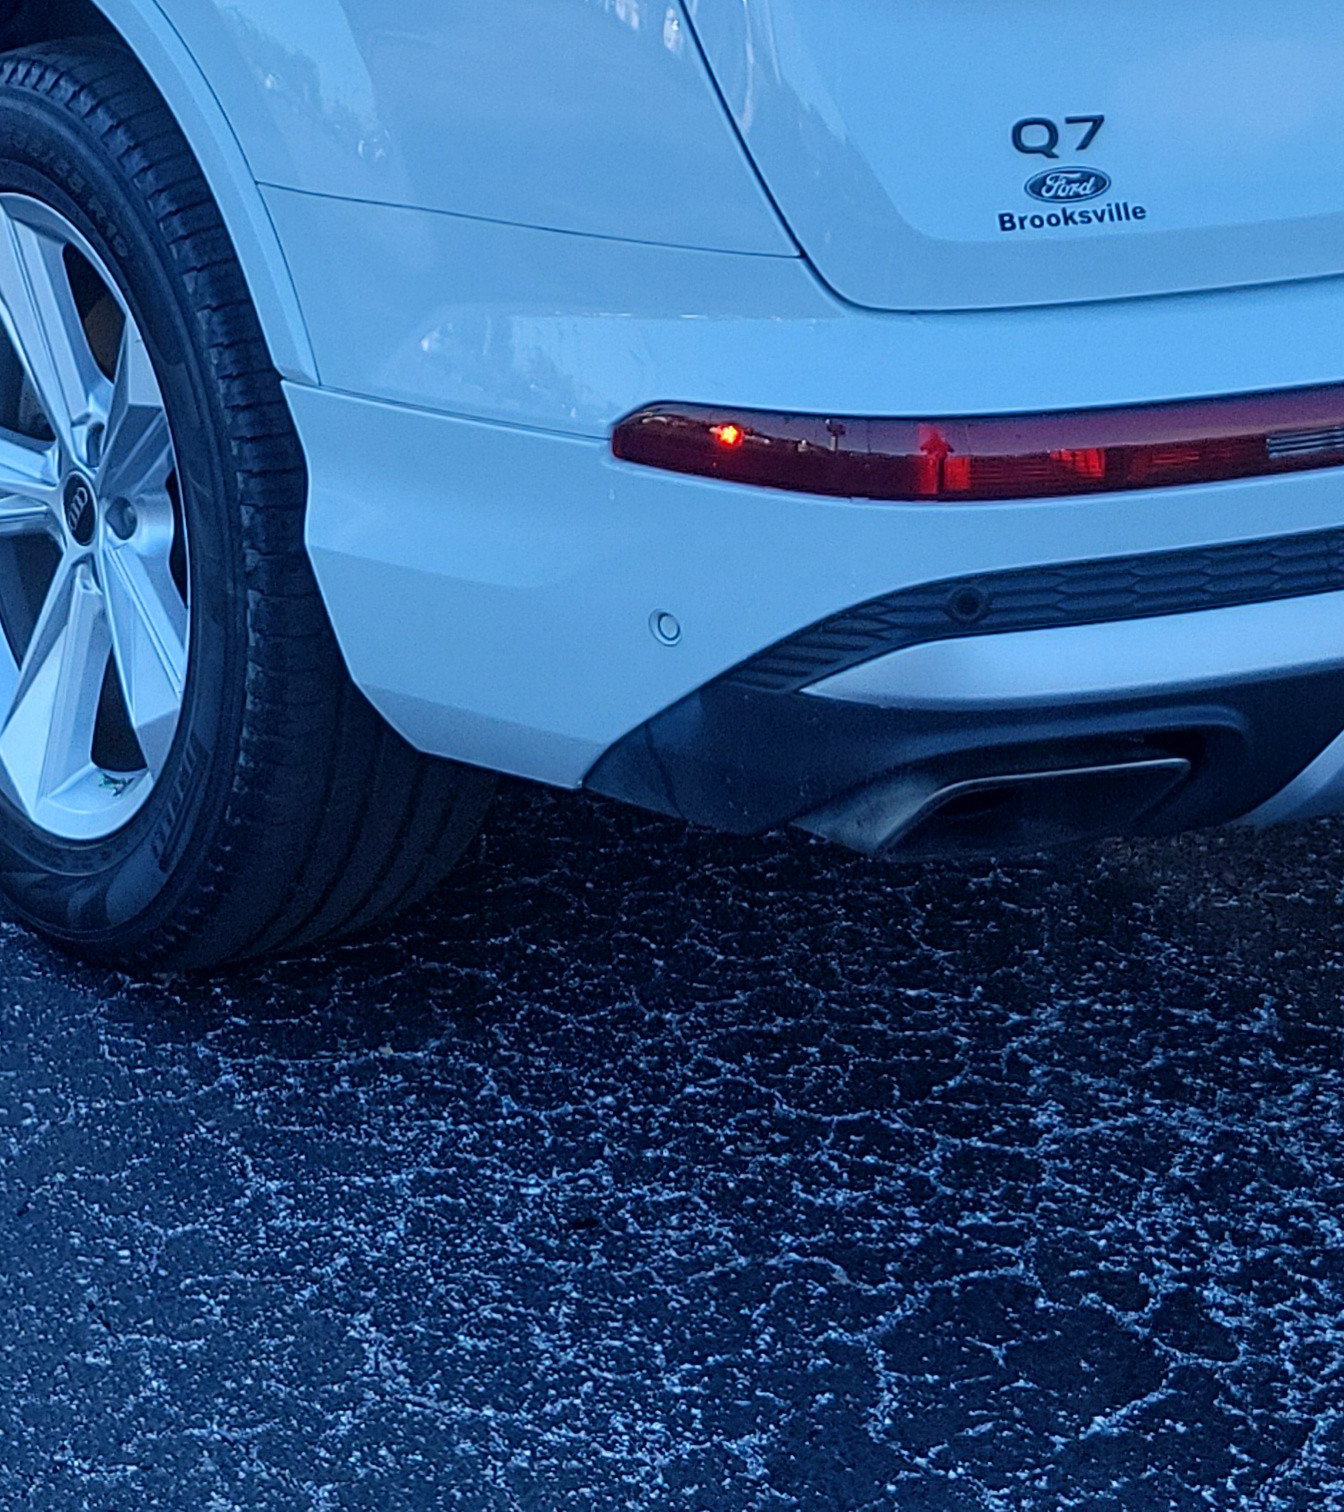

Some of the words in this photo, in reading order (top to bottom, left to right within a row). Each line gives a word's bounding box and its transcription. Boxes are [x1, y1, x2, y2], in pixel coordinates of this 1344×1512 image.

[1011, 114, 1105, 158] Q7
[1040, 171, 1096, 198] Ford
[997, 201, 1147, 232] Brooksville
